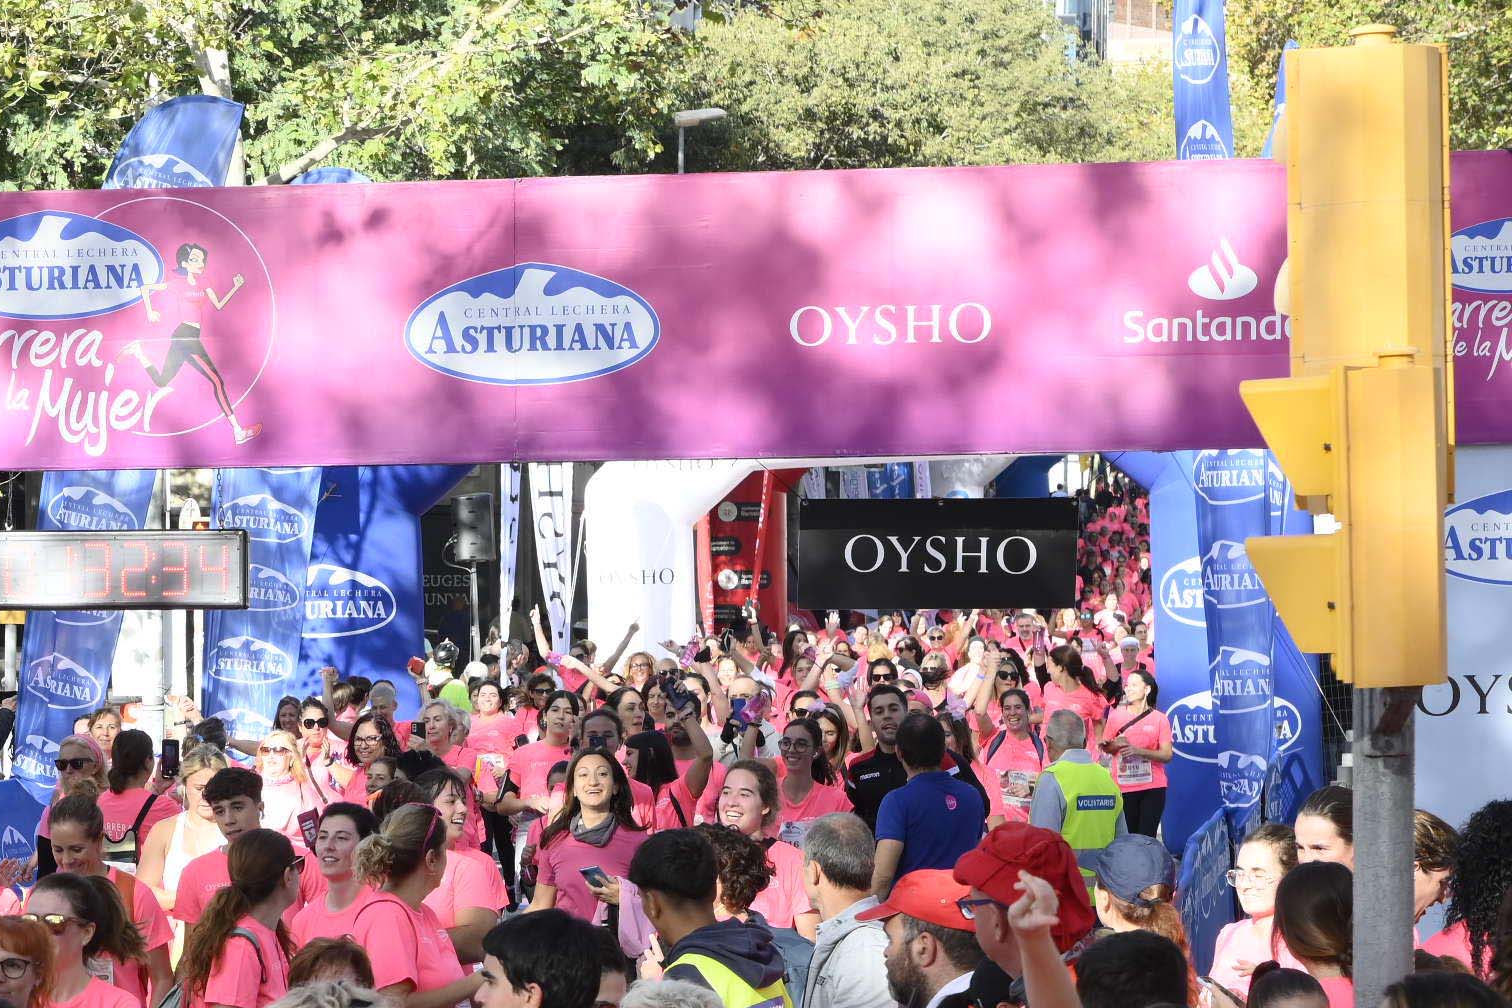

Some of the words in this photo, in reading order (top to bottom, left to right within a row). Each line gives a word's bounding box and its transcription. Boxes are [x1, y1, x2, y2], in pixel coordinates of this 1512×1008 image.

[66, 247, 139, 259] LECHERA
[463, 306, 543, 318] CENTRAL
[550, 304, 632, 316] LECHERA
[789, 302, 993, 347] OYSHO
[1451, 299, 1512, 329] arre
[424, 310, 641, 355] ASTURIANA
[1473, 328, 1492, 357] la
[6, 374, 30, 411] la
[25, 363, 174, 457] Mujer
[223, 509, 300, 535] ASTURIANA
[1470, 521, 1512, 532] CENT
[844, 533, 1038, 575] OYSHO
[1417, 673, 1512, 717] OY
